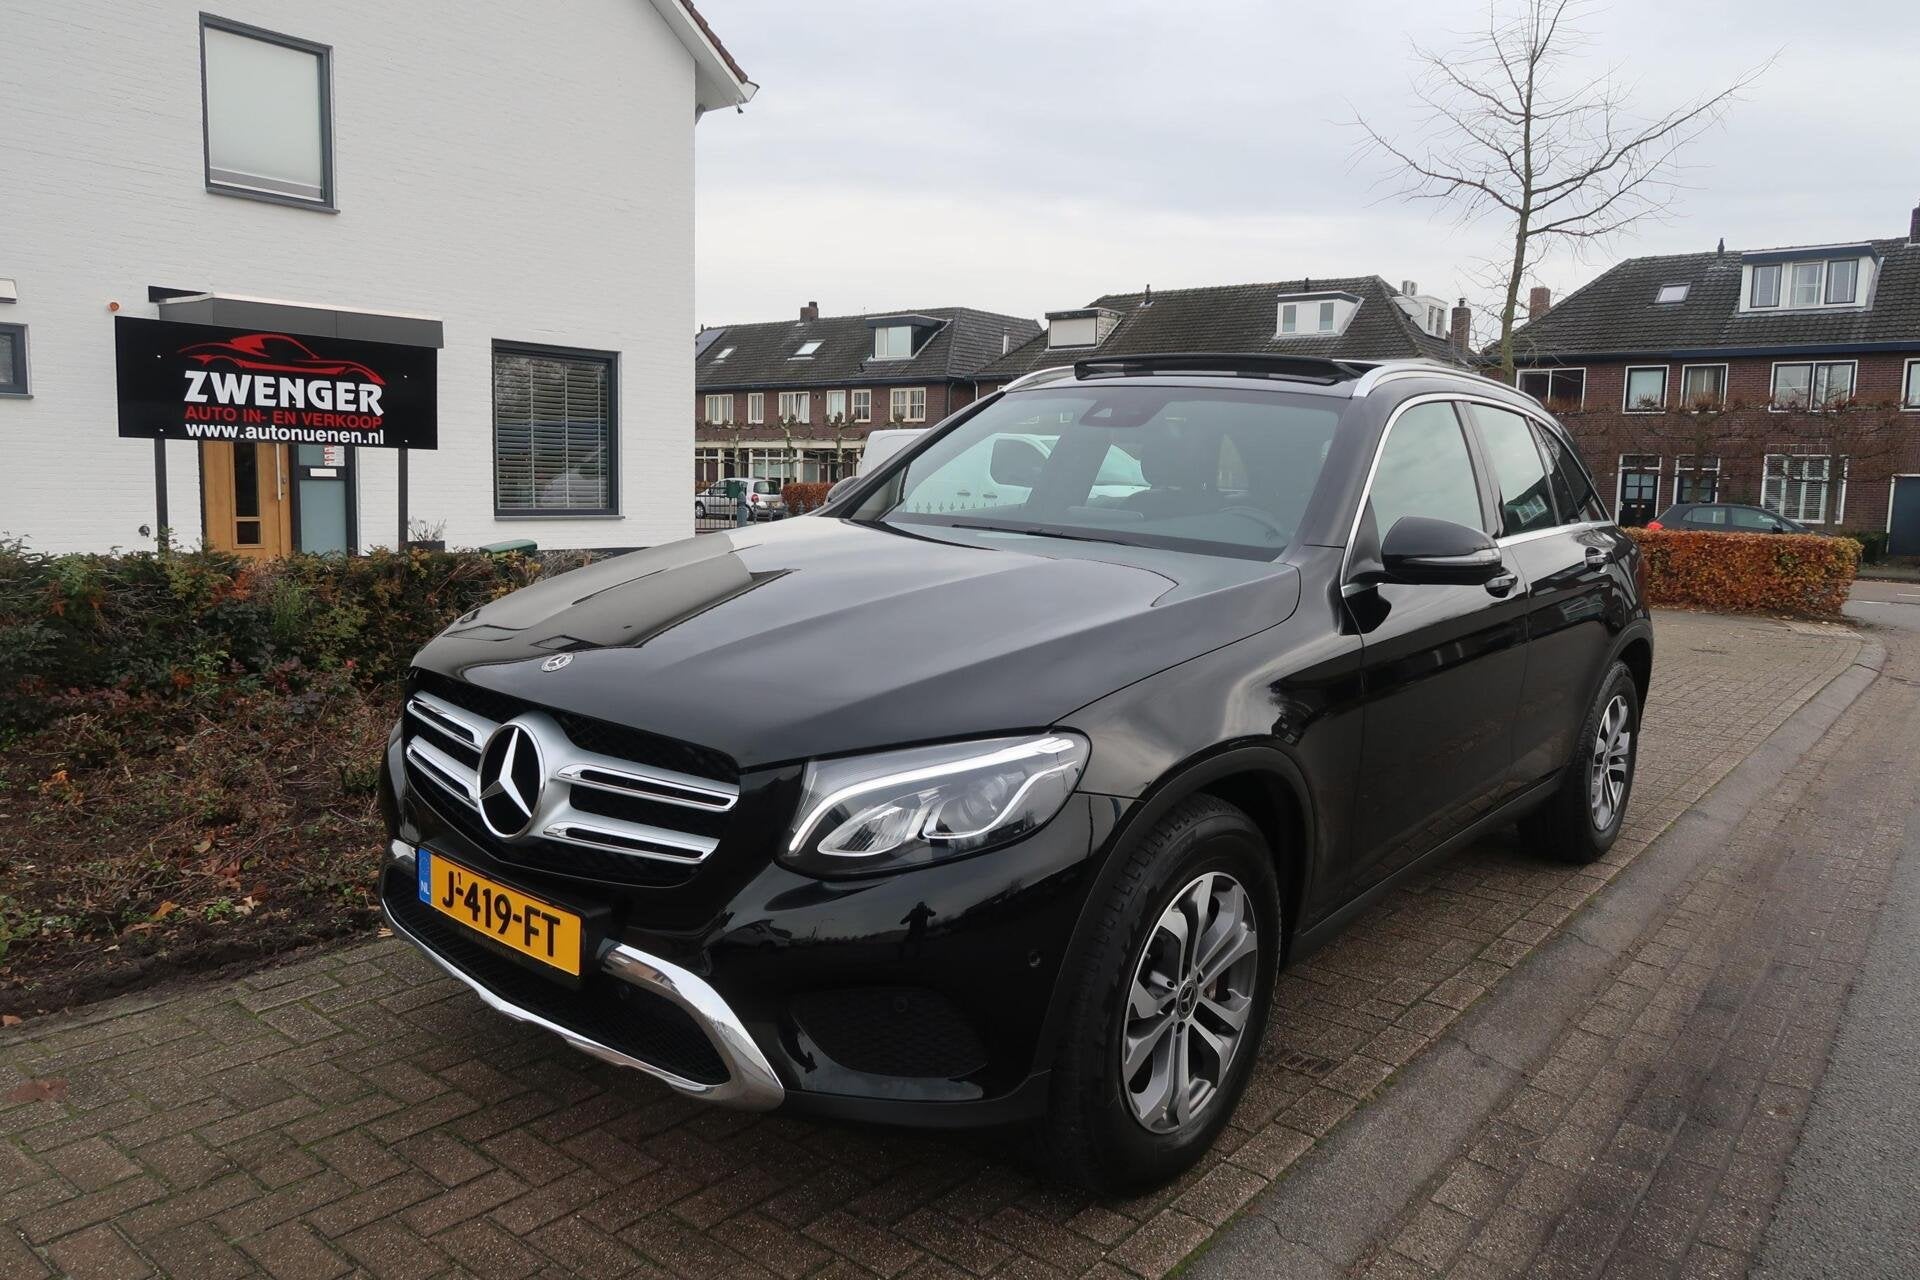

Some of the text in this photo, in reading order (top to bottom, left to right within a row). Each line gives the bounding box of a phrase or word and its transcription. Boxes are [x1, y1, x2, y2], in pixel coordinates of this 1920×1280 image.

[184, 370, 384, 416] ZWENGER
[184, 405, 383, 430] AUTO IN- EN VERKOOP
[185, 423, 385, 445] www.autonuenen.nl
[420, 880, 430, 895] NL
[442, 870, 561, 957] J-419-FT
